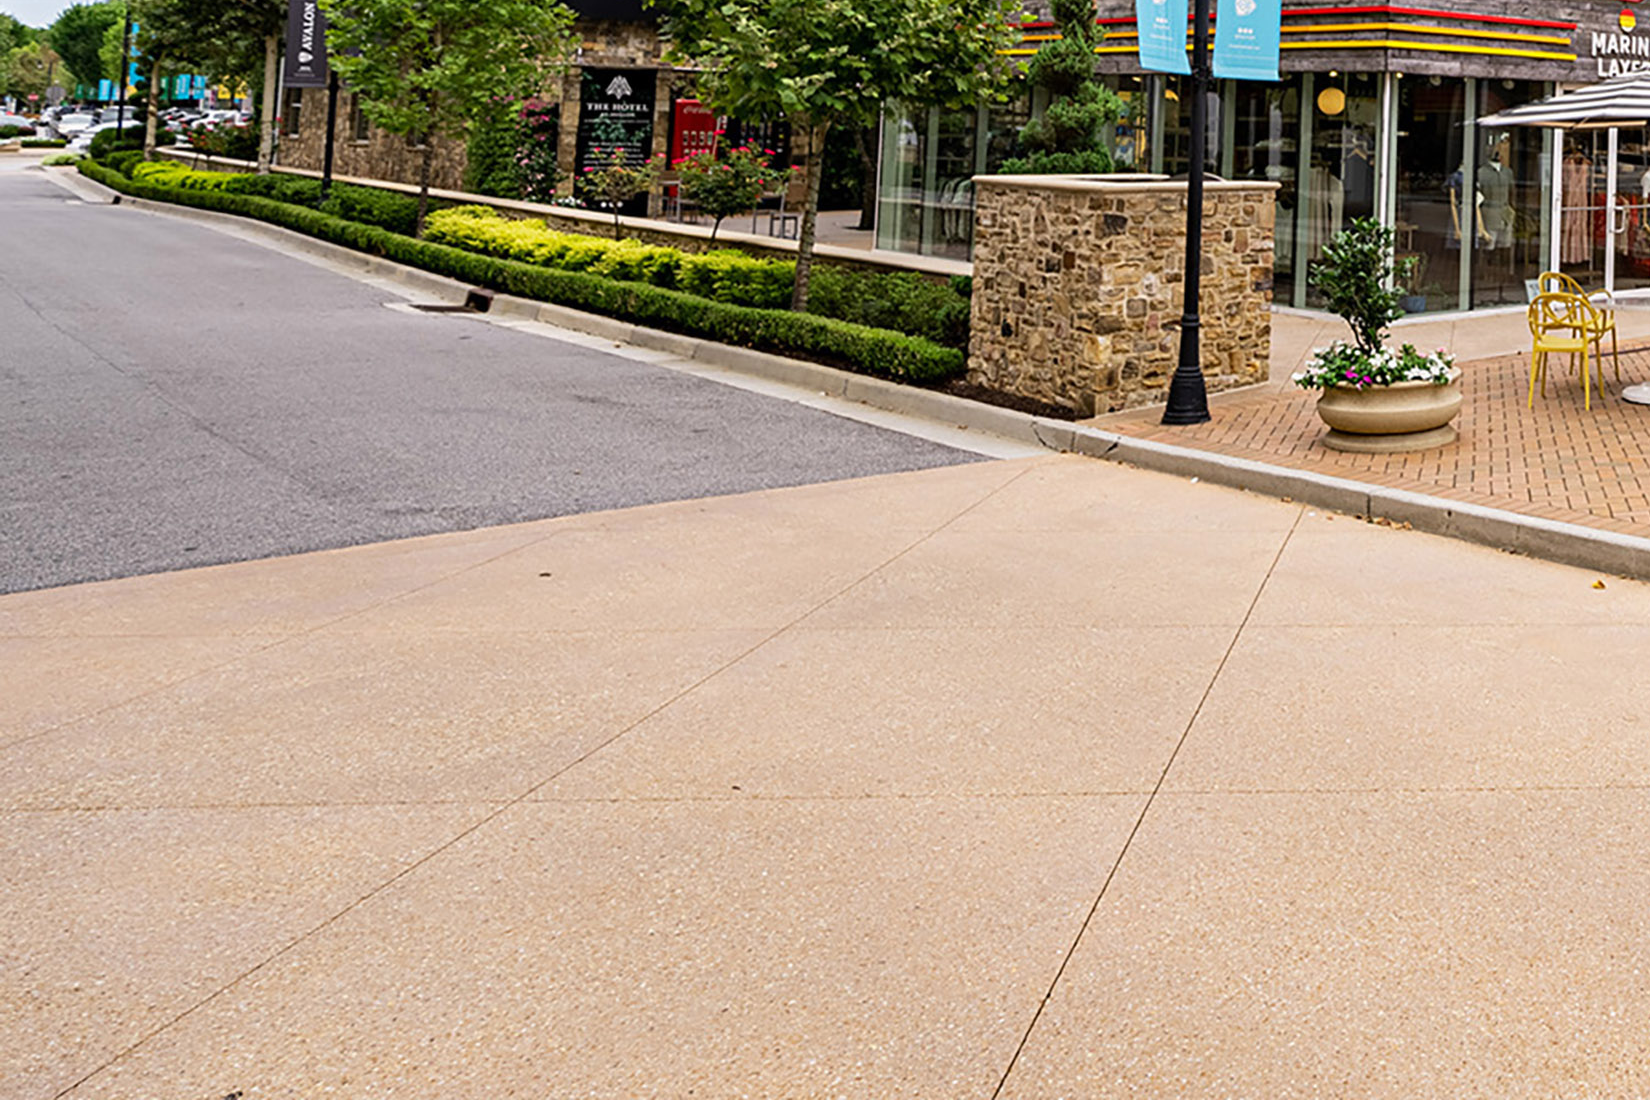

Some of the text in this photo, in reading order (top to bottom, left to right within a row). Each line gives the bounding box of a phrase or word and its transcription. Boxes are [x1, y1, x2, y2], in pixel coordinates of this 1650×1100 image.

[301, 1, 315, 51] AVALON
[586, 102, 649, 112] THE HOTEL
